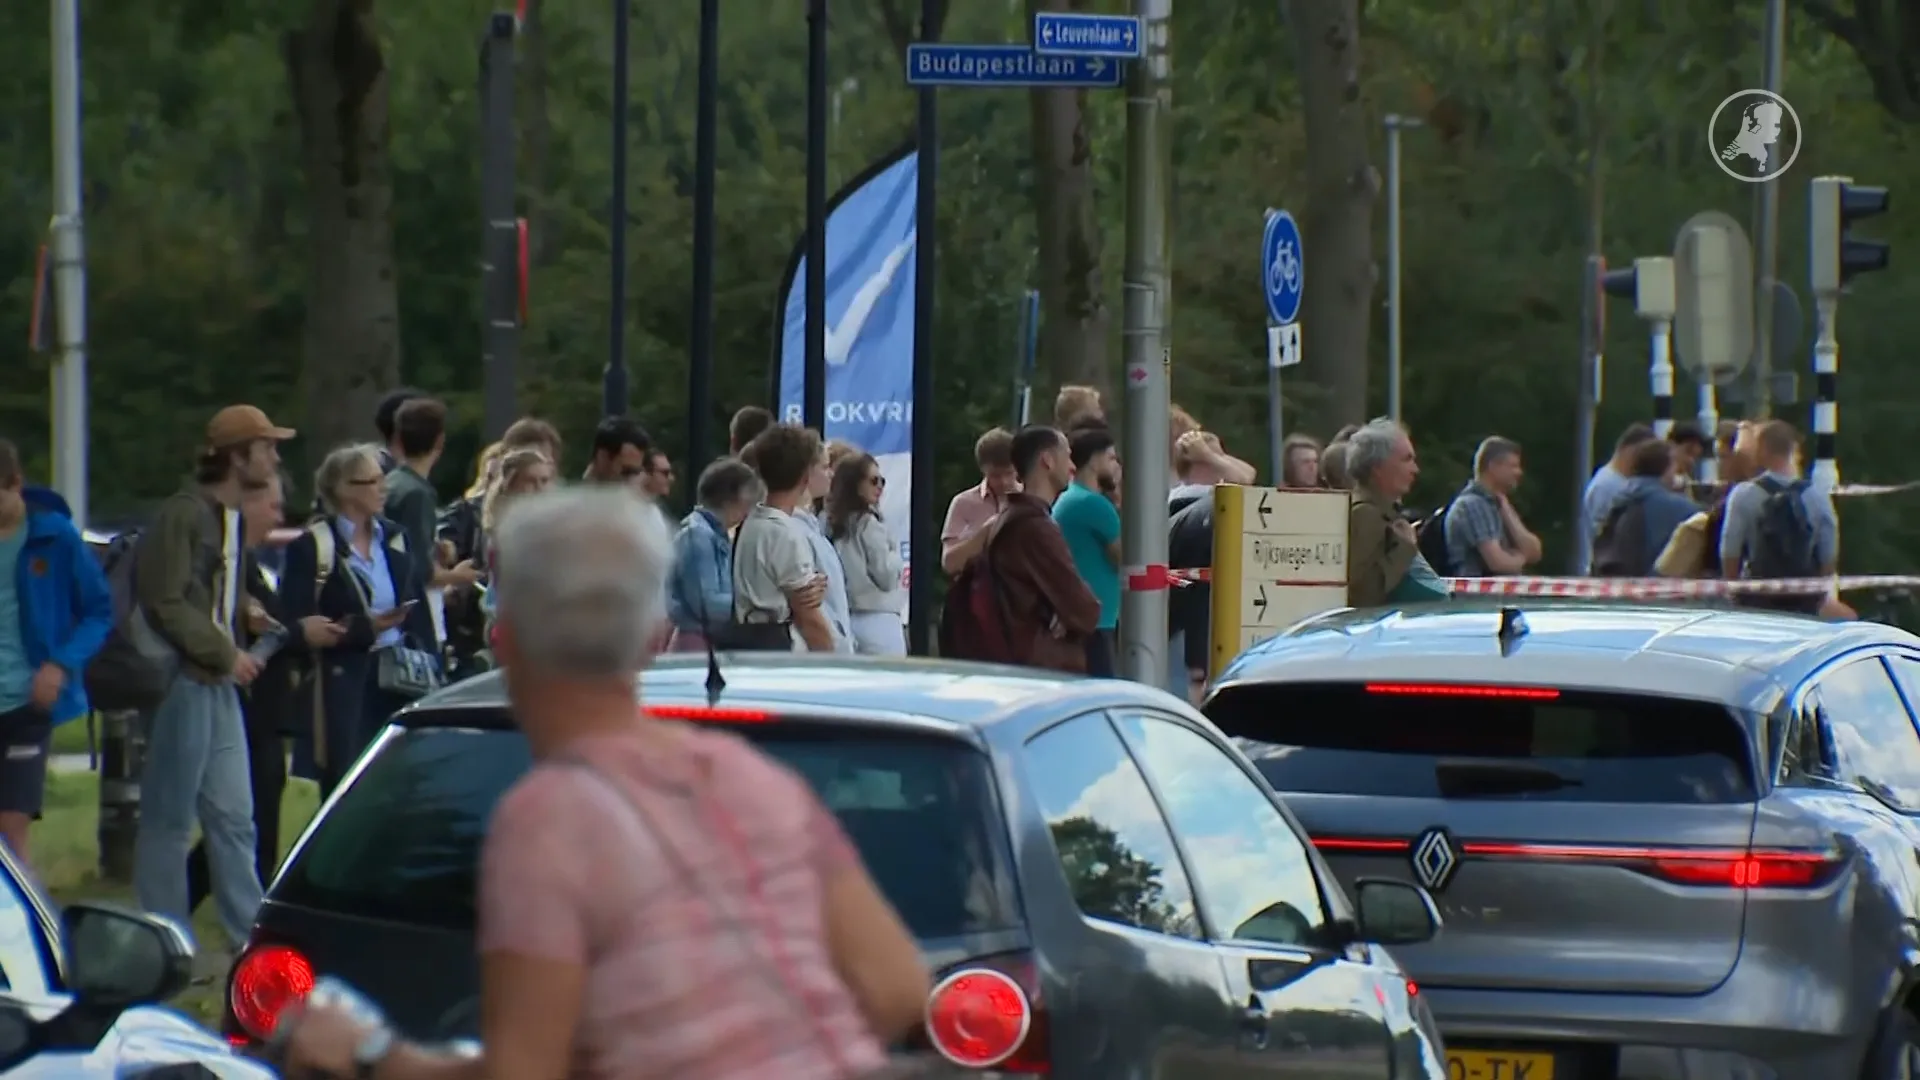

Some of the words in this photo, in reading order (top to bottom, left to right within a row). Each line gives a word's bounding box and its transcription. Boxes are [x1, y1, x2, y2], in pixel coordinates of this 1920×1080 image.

[1055, 21, 1121, 44] Leuvenlaan
[918, 52, 1076, 78] Budapestlaan
[785, 401, 912, 424] ROKVRI
